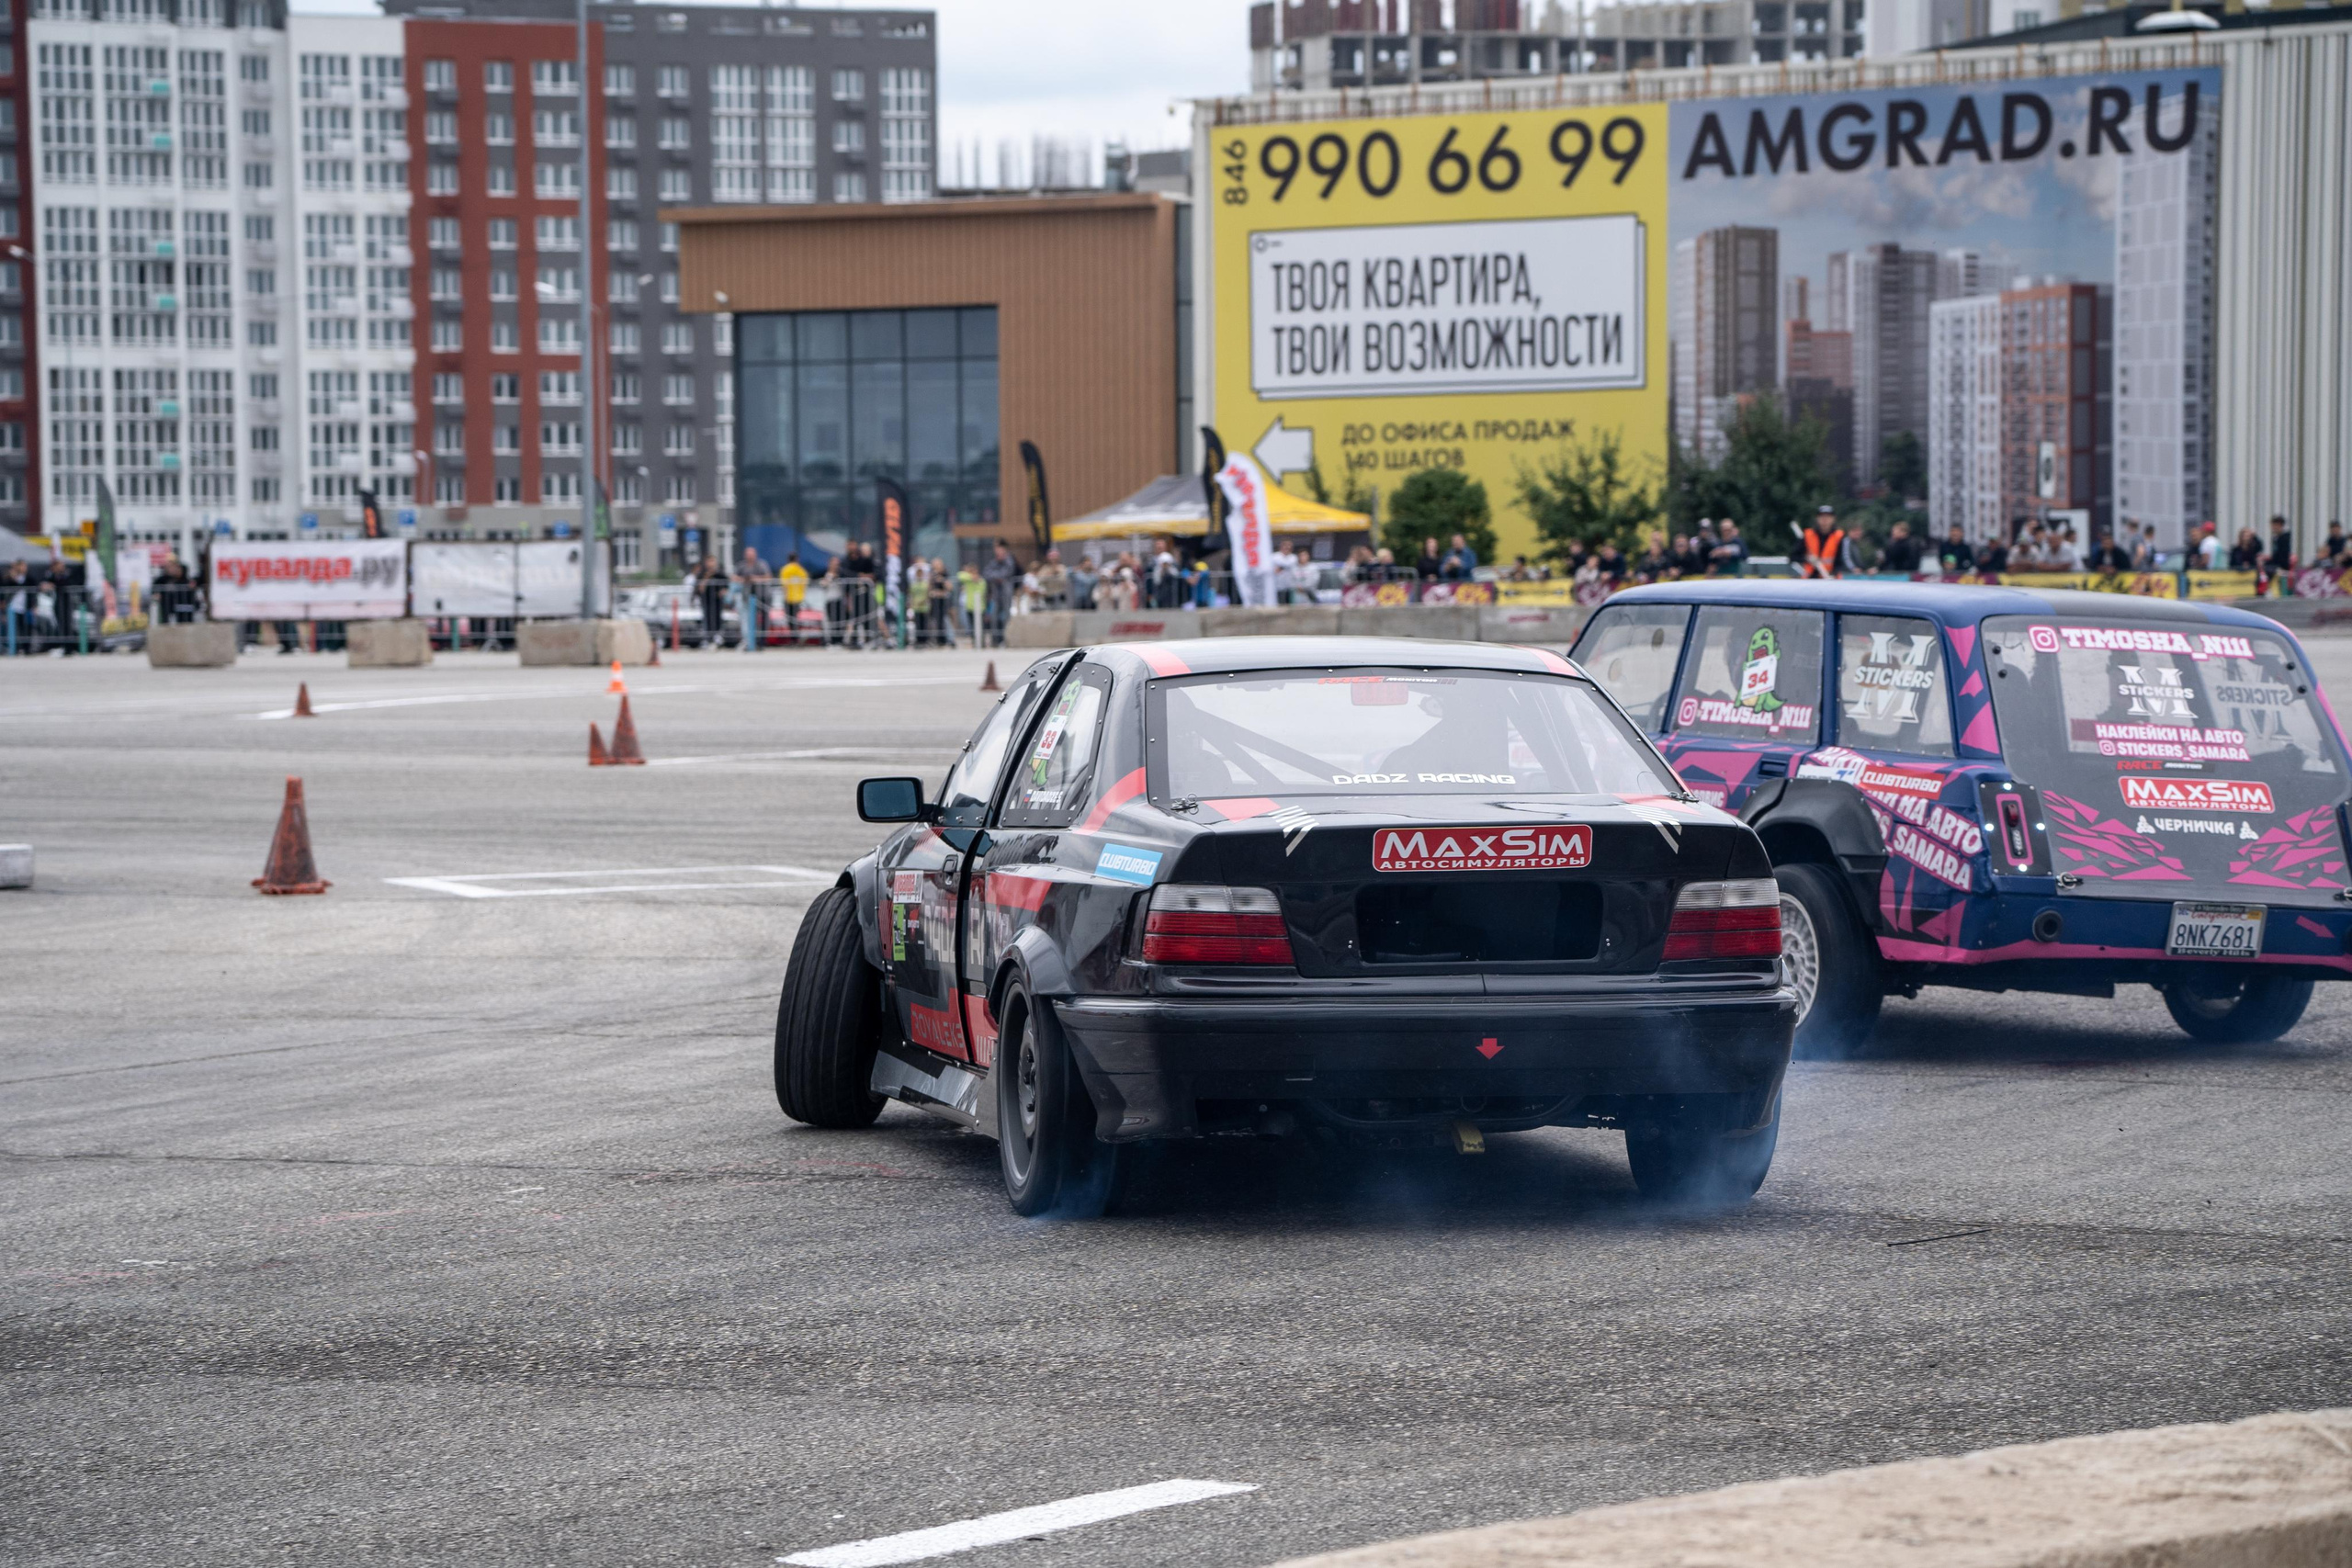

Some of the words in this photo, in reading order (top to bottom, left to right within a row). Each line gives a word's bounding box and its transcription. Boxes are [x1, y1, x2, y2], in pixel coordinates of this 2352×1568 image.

[1683, 82, 2199, 179] AMGRAD.RU
[1260, 130, 1401, 203] 990
[1428, 125, 1521, 195] 66
[1549, 118, 1645, 188] 99
[1223, 140, 1248, 205] 846
[1272, 260, 1350, 313] ТВОЯ
[1363, 253, 1542, 310] КВАРТИРА,
[1272, 324, 1350, 376] ТВОИ
[1365, 314, 1623, 372] ВОЗМОЖНОСТИ
[1341, 423, 1376, 446] ДО
[1381, 421, 1468, 443] ОФИСА
[1473, 418, 1575, 442] ПРОДАЖ
[1385, 447, 1464, 470] ШАГОВ
[216, 554, 400, 588] кувалда.ру
[1317, 676, 1383, 685] RACE
[1747, 671, 1769, 689] 34
[1854, 666, 1934, 689] STICKERS
[2119, 684, 2195, 699] STICKERS
[2095, 724, 2177, 741] НАКЛЕЙКИ
[2179, 728, 2202, 742] НА
[2204, 730, 2245, 744] АВТО
[2117, 741, 2250, 761] STICKERS_SAMARA
[2117, 761, 2163, 770] RACE
[1332, 773, 1408, 785] DADZ
[1418, 773, 1516, 784] RACING
[1863, 771, 1942, 793] CLUBTURBO
[2130, 799, 2271, 811] АВТОСИМУЛЯТОРЫ
[1897, 795, 1928, 826] НА
[1927, 807, 1983, 854] АВТО
[2154, 818, 2235, 835] ЧЕРНИЧКА
[1099, 852, 1158, 875] CLUBTURBO
[1380, 857, 1585, 869] АВТОСИМУЛЯТОРЫ
[2176, 924, 2254, 948] 8NKZ681
